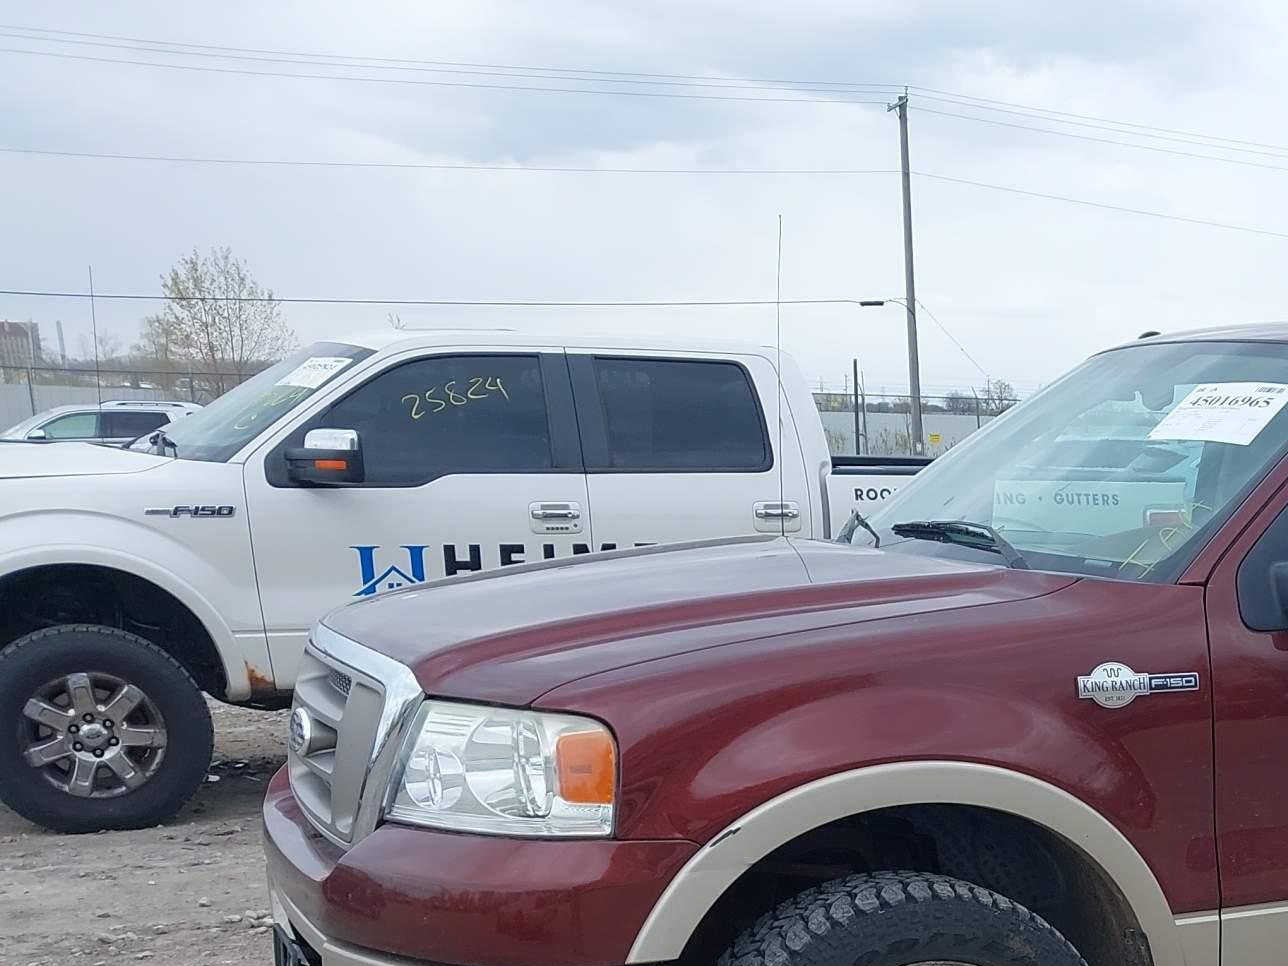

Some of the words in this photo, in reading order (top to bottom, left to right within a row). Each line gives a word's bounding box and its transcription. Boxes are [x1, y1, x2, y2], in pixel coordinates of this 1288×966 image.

[401, 377, 510, 419] 25824
[1189, 396, 1275, 408] 45016965
[854, 488, 898, 501] ROO
[1054, 492, 1120, 506] GUTTERS
[169, 504, 236, 518] F-150
[1082, 679, 1109, 693] KING
[1112, 677, 1146, 691] RANCH
[1151, 677, 1196, 688] F-150
